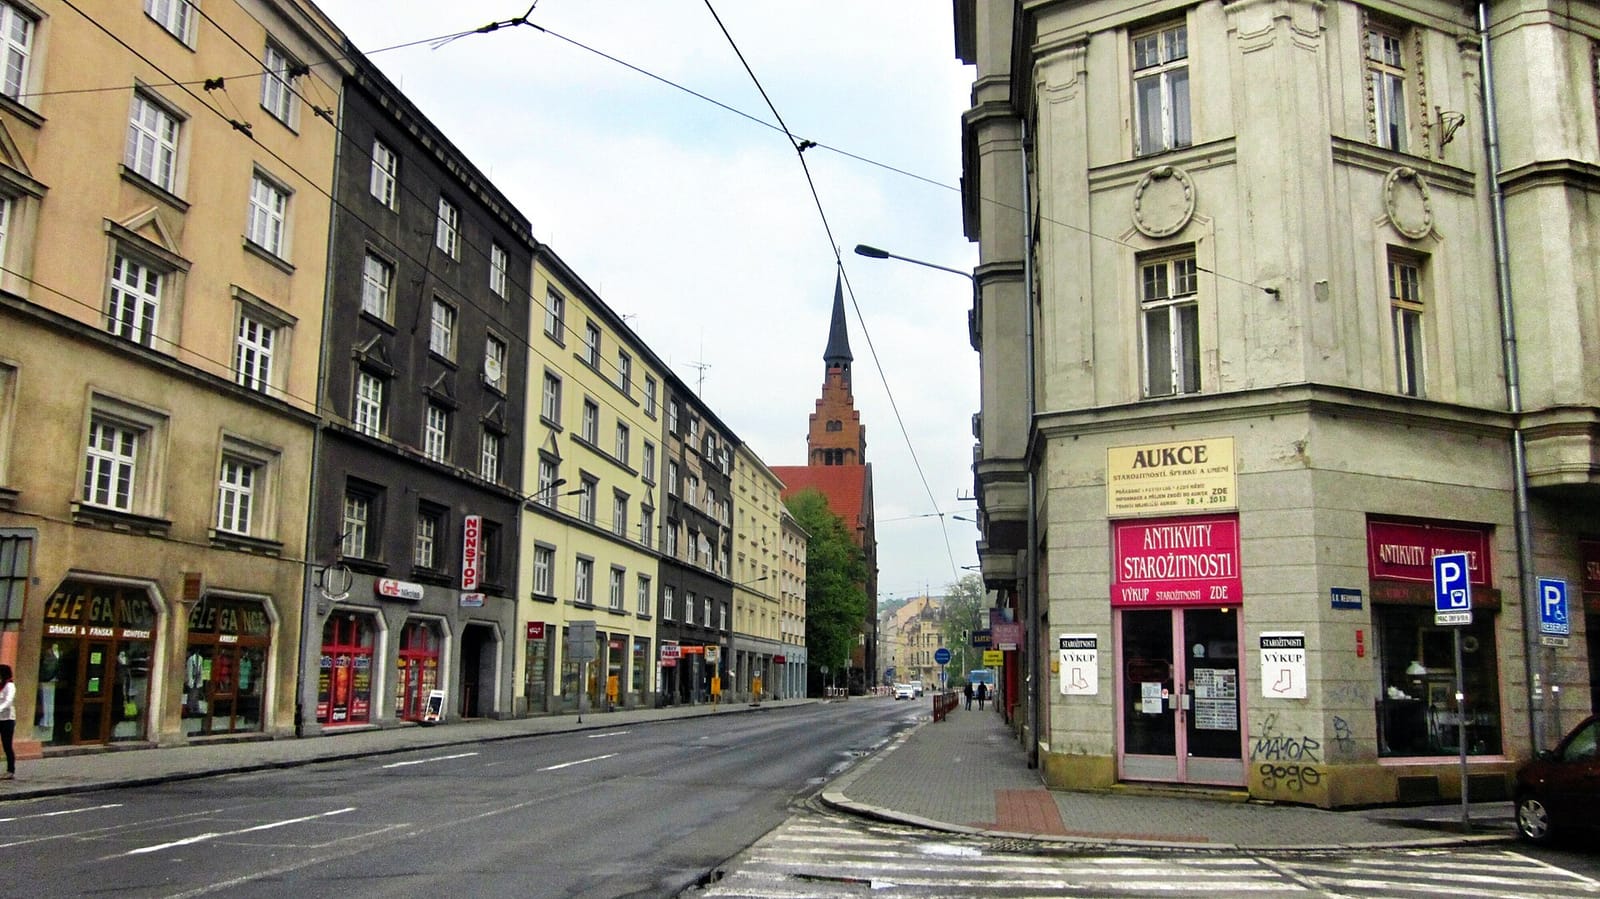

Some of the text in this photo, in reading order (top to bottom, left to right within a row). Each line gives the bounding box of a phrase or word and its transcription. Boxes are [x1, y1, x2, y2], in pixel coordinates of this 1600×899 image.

[1132, 445, 1208, 469] AUKCE
[1212, 487, 1228, 495] ZDE
[1144, 525, 1212, 549] ANTIKVITY
[464, 519, 477, 587] NONSTOP
[1380, 543, 1425, 566] ANTIKVITY
[1124, 552, 1232, 579] STAROŽITNOSTI
[1122, 586, 1150, 602] VÝKUP
[1210, 586, 1228, 599] ZDE
[1063, 651, 1095, 662] VÝKUP
[1264, 652, 1302, 663] VÝKUP
